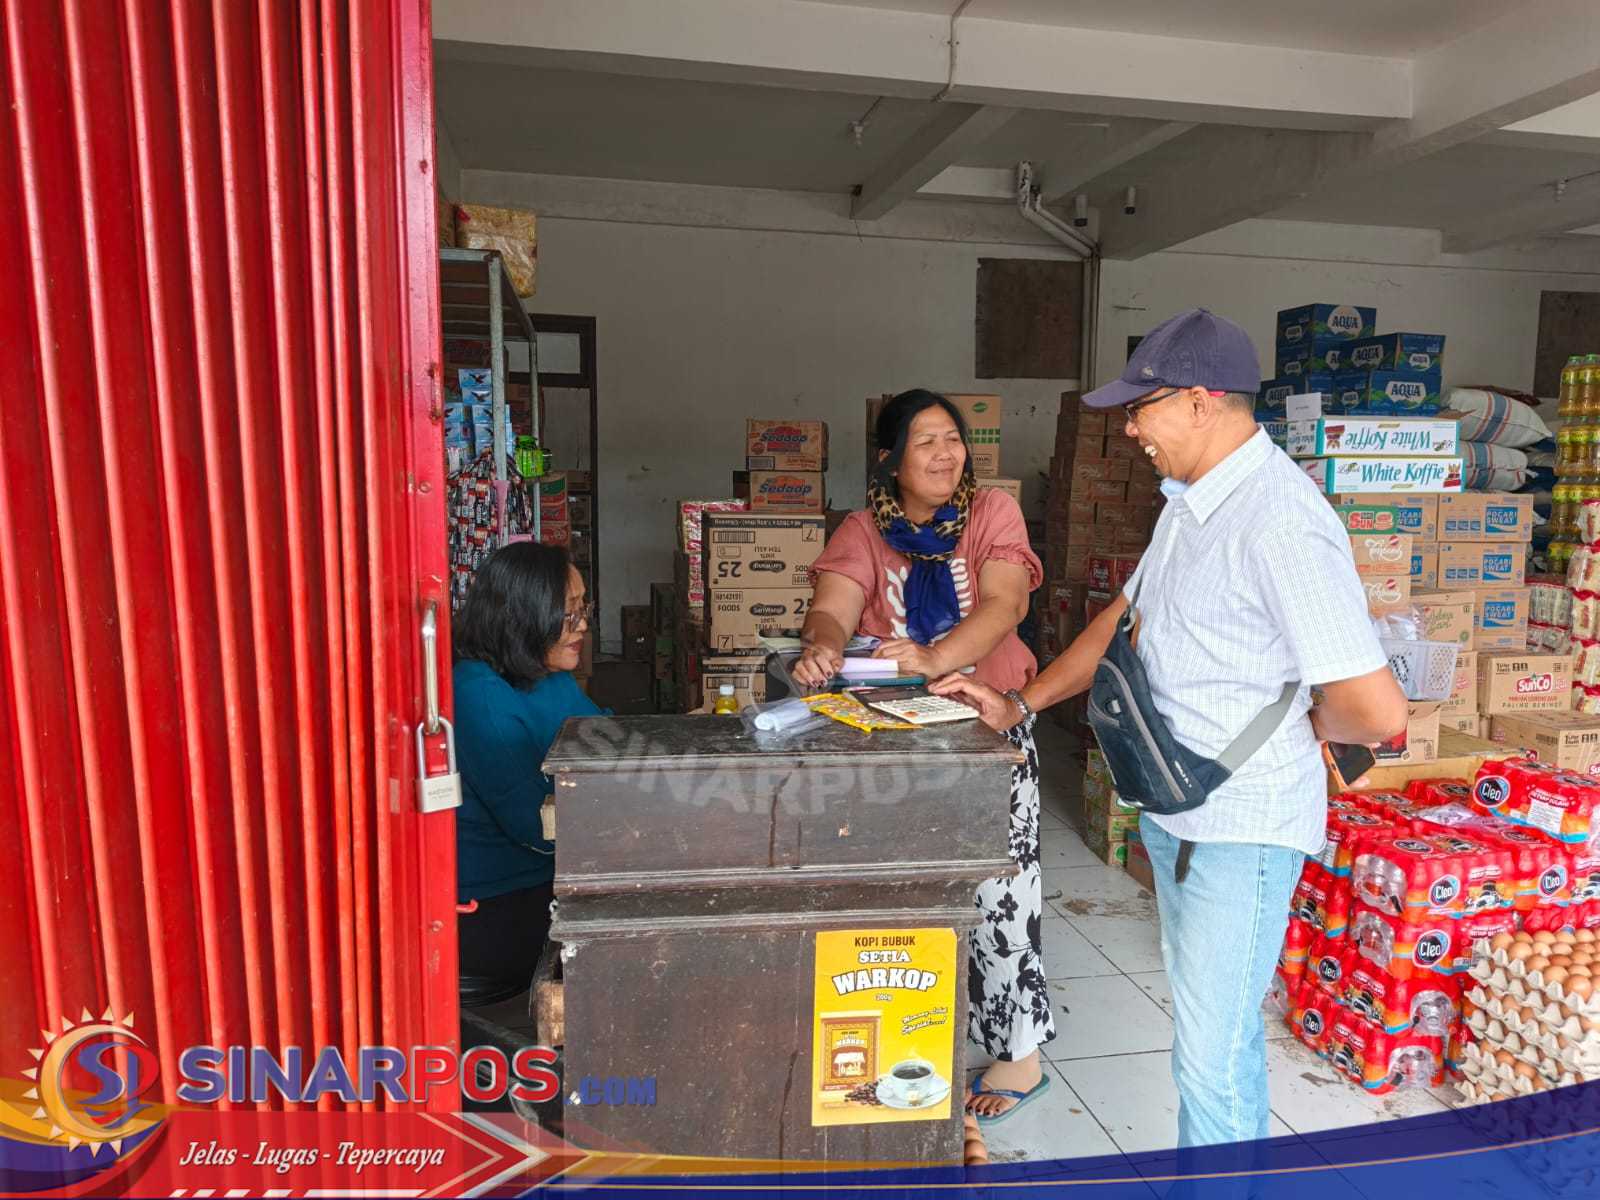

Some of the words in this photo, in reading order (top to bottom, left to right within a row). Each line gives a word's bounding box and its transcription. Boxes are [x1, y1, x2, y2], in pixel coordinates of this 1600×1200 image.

[1331, 314, 1359, 331] AQUA
[1355, 347, 1380, 363] AQUA
[1411, 355, 1429, 365] AQUA
[1390, 383, 1422, 398] AQUA
[1344, 427, 1388, 453] Koffie
[1391, 430, 1432, 449] White
[1361, 462, 1401, 483] White
[1404, 463, 1445, 485] Koffie
[758, 482, 813, 497] Sedaap
[1486, 510, 1518, 519] POCARI
[1486, 517, 1514, 526] SWEAT
[1483, 557, 1512, 566] POCARI
[718, 561, 742, 578] 25
[717, 604, 741, 612] FOODS
[1486, 605, 1515, 613] POCARI
[721, 636, 730, 648] 7
[1517, 675, 1551, 692] SunCo
[1482, 783, 1502, 801] Cleo
[1545, 875, 1561, 888] Cleo
[1435, 885, 1453, 899] Cleo
[854, 936, 879, 947] KOPI
[881, 935, 916, 947] BUBUK
[858, 949, 912, 964] SETIA
[1419, 941, 1442, 957] Cleo
[831, 967, 938, 997] WARKOP
